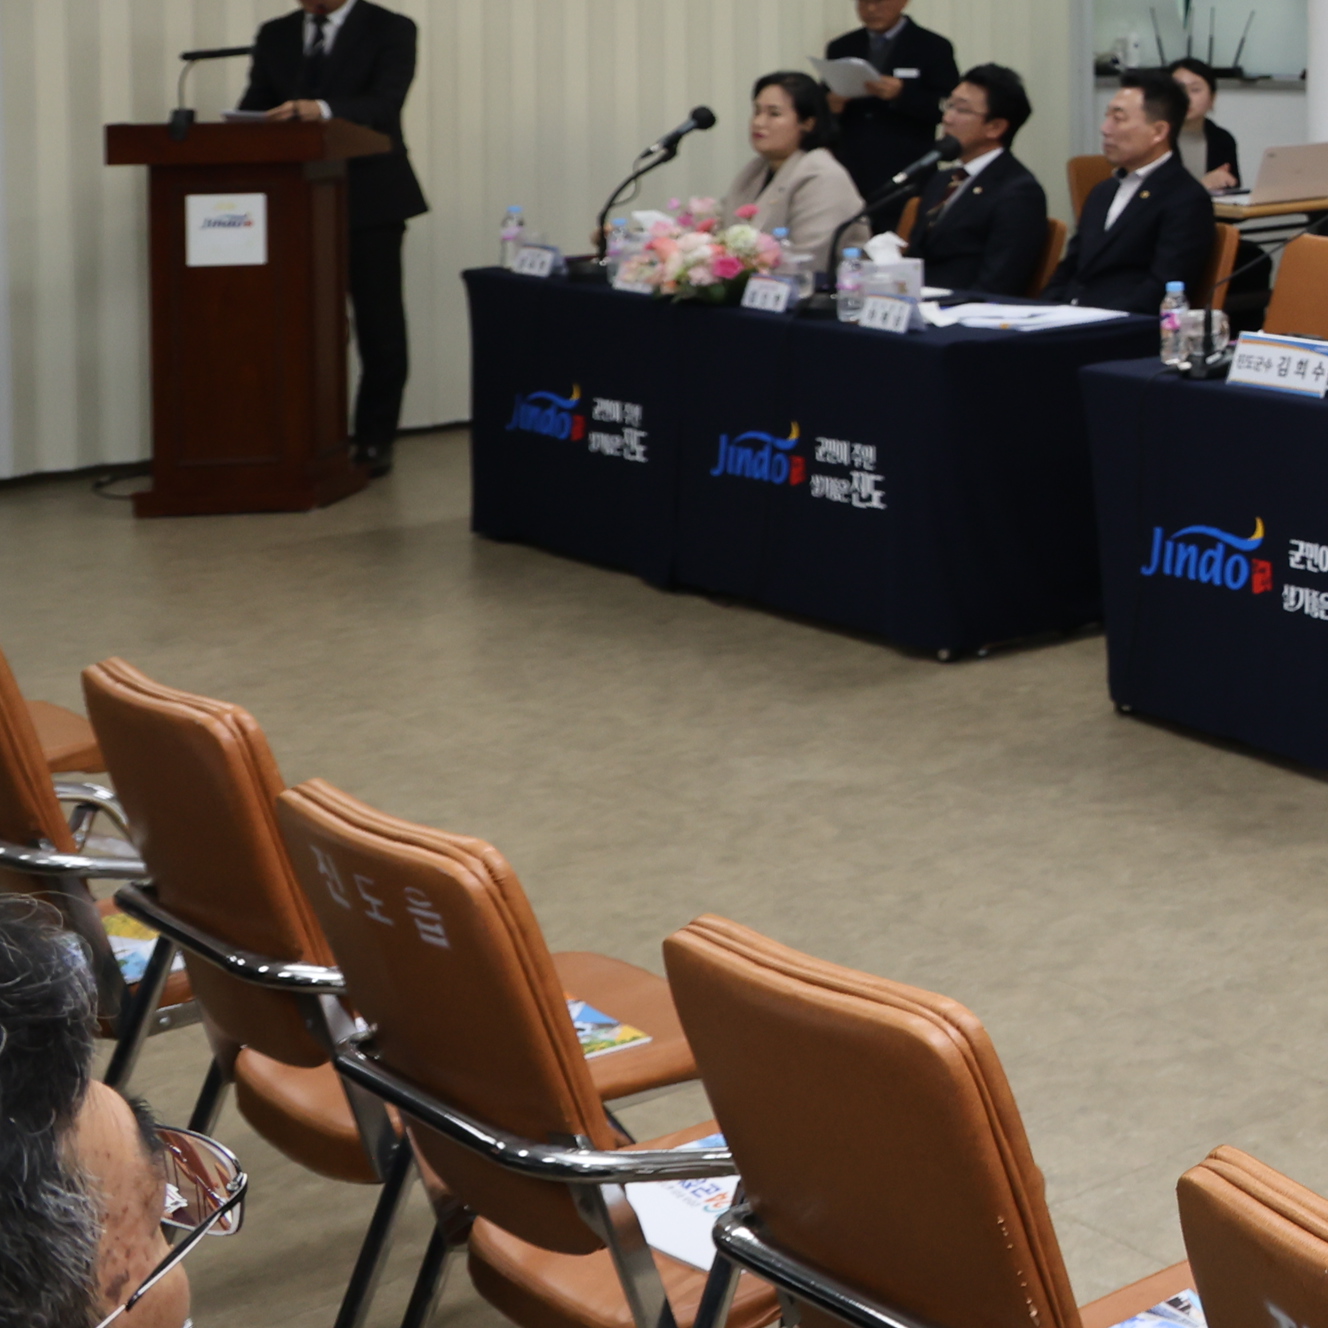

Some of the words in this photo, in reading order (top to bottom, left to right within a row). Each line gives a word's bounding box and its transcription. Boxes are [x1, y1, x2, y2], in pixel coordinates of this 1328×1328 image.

[1277, 355, 1326, 383] 김희수
[710, 434, 791, 485] Jindo
[1140, 526, 1249, 590] Jindo
[309, 844, 451, 949] 진도읍
